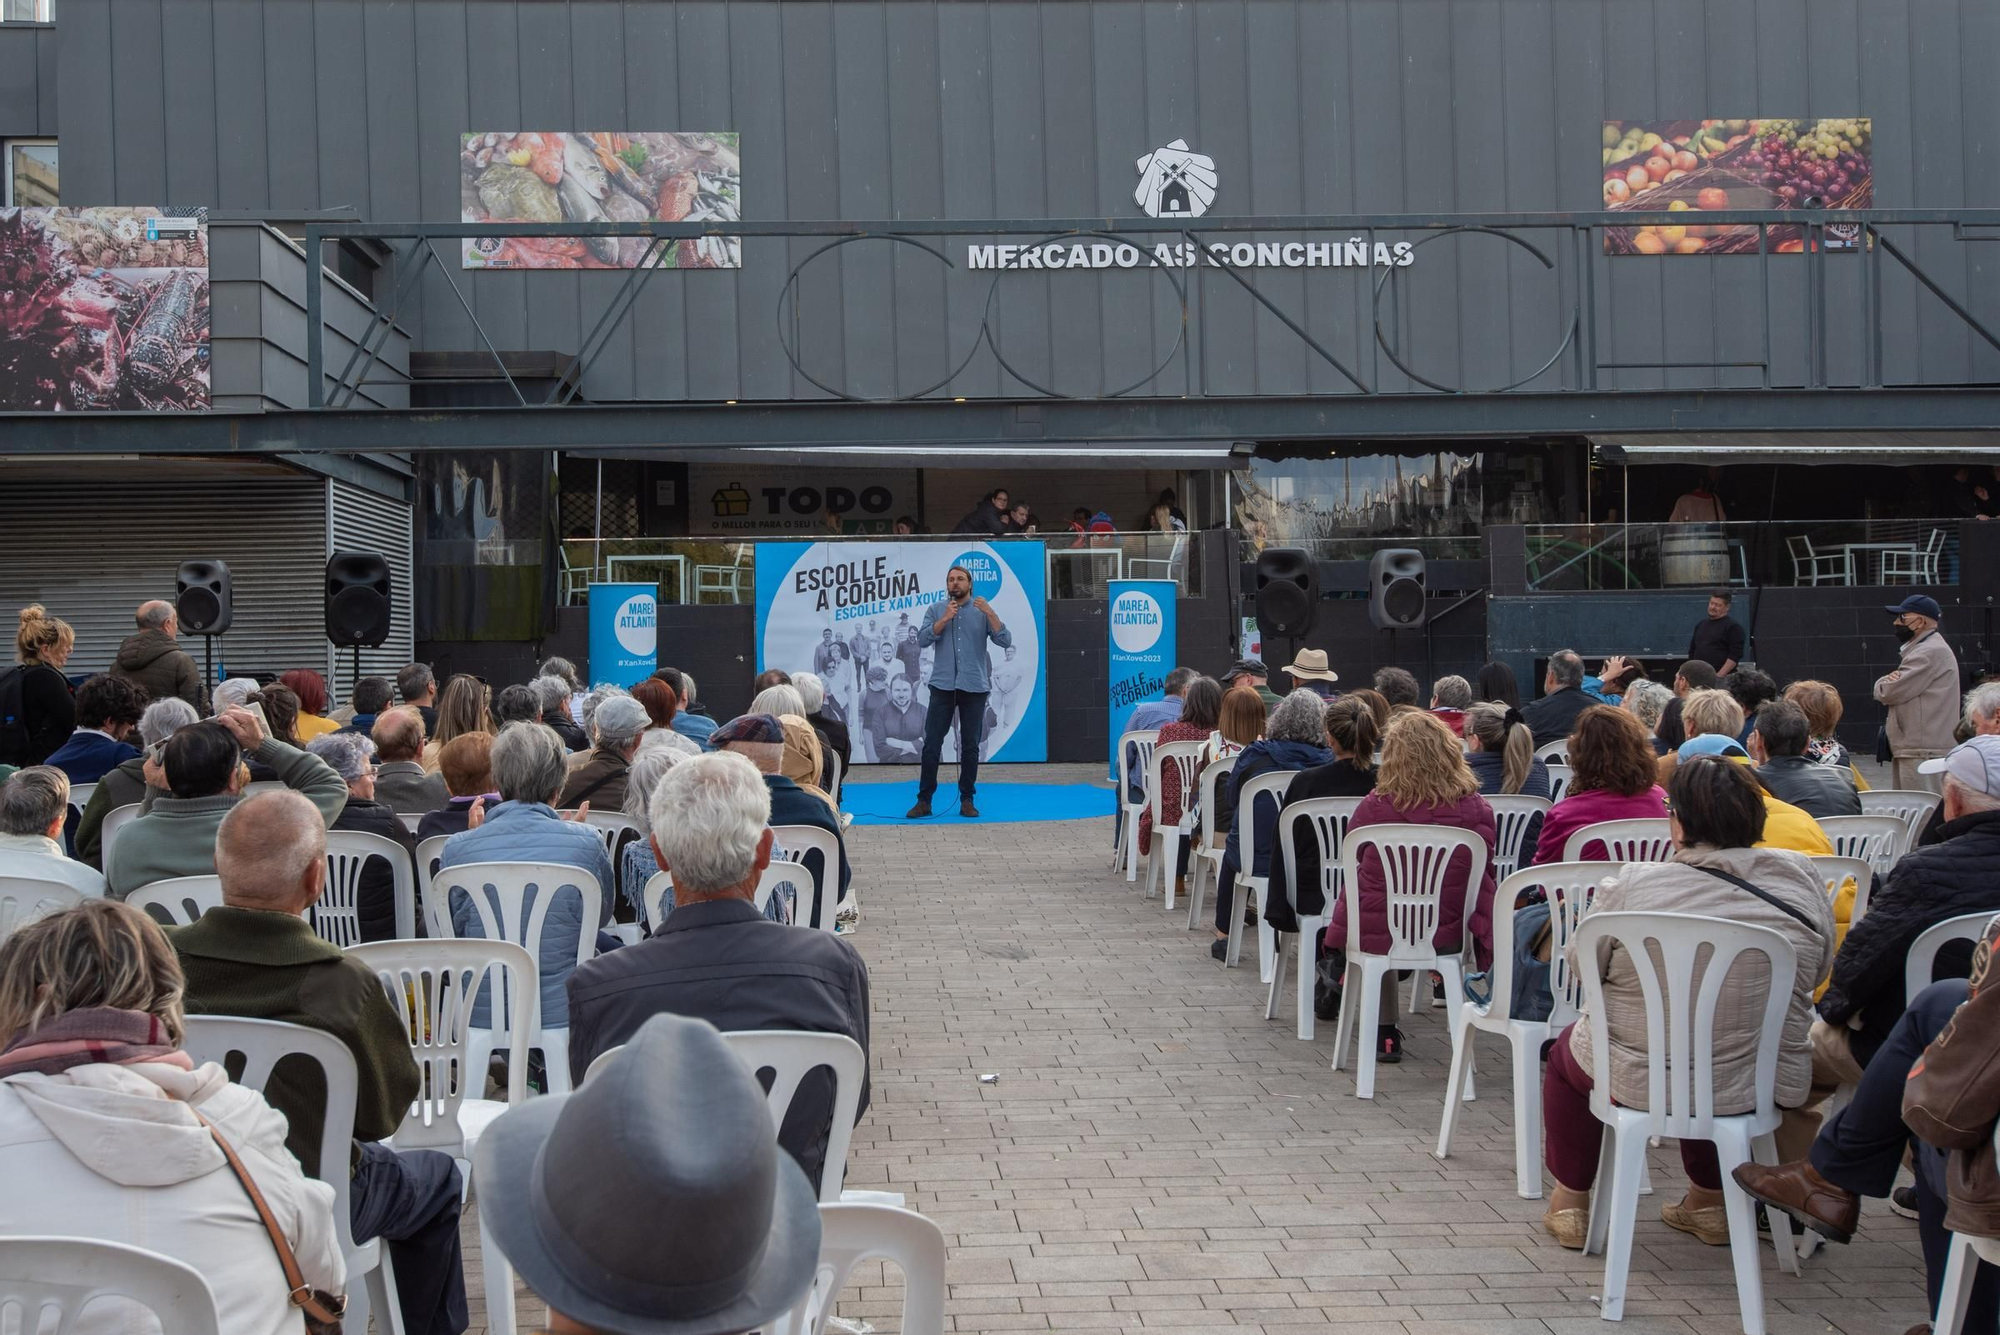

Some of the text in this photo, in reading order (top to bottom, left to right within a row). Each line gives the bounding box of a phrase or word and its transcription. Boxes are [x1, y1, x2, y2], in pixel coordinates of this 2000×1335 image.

[968, 236, 1415, 269] MERCADO AS CONCHIÑAS
[762, 486, 893, 515] TODO
[712, 521, 719, 529] O
[721, 520, 756, 529] MELLOR
[759, 520, 782, 528] PARA
[784, 520, 792, 528] O
[794, 520, 810, 528] SEU
[795, 556, 887, 594] ESCOLLE
[959, 558, 990, 570] MAREA
[815, 569, 921, 612] A CORUÑA
[835, 589, 946, 621] ESCOLLE XAN XOVE
[628, 602, 655, 615] MAREA
[1118, 599, 1150, 612] MAREA
[1112, 653, 1161, 662] #XanXove2023
[1115, 677, 1164, 710] A CORUÑA
